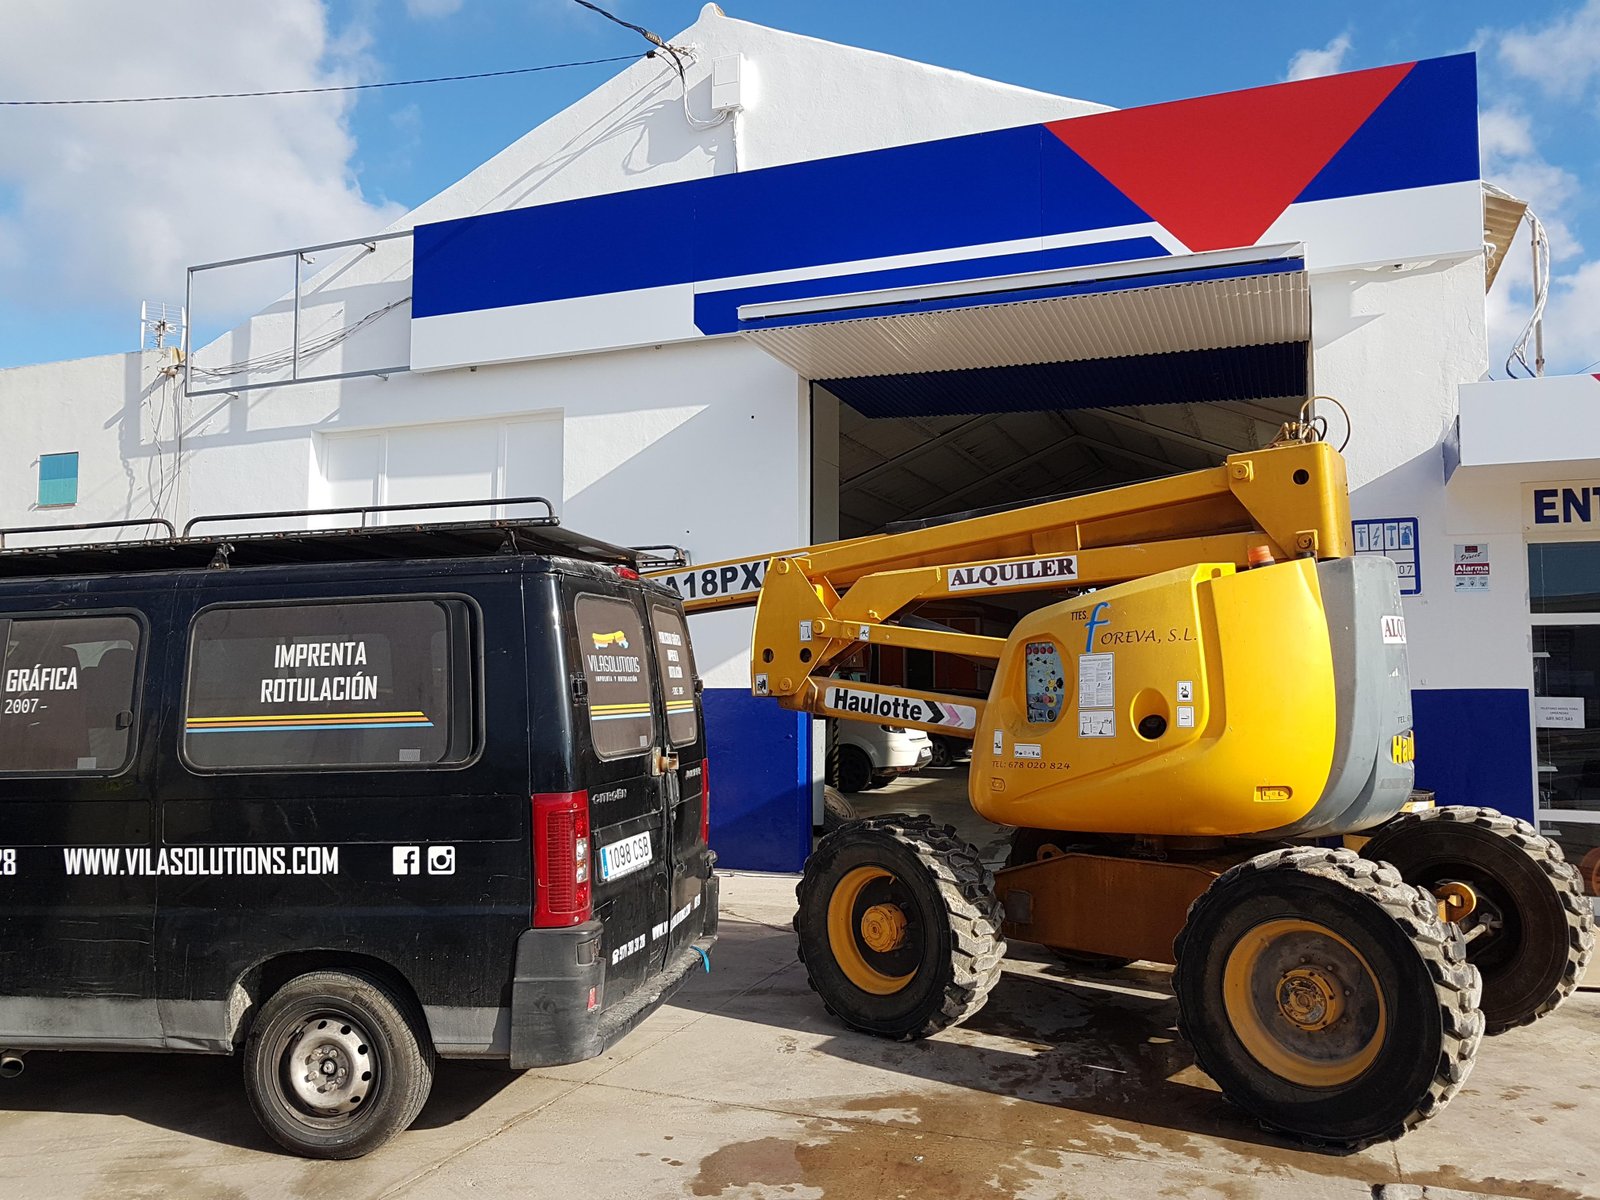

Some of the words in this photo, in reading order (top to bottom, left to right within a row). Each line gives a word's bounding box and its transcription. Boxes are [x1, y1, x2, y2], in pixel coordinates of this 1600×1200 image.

[951, 558, 1075, 585] ALQUILER
[1455, 564, 1489, 572] Alarma
[1071, 610, 1088, 620] TTES.
[1167, 627, 1197, 643] S.L.
[274, 641, 367, 668] IMPRENTA
[5, 664, 78, 692] GRÁFICA
[260, 671, 378, 703] ROTULACIÓN
[834, 688, 922, 720] Haulotte
[992, 760, 1006, 769] TEL:
[1008, 761, 1024, 769] 678
[1027, 761, 1046, 769] 020
[1049, 762, 1071, 770] 824
[64, 847, 339, 875] WWW.VILASOLUTIONS.COM
[609, 843, 632, 870] 1098
[633, 836, 650, 860] CSB
